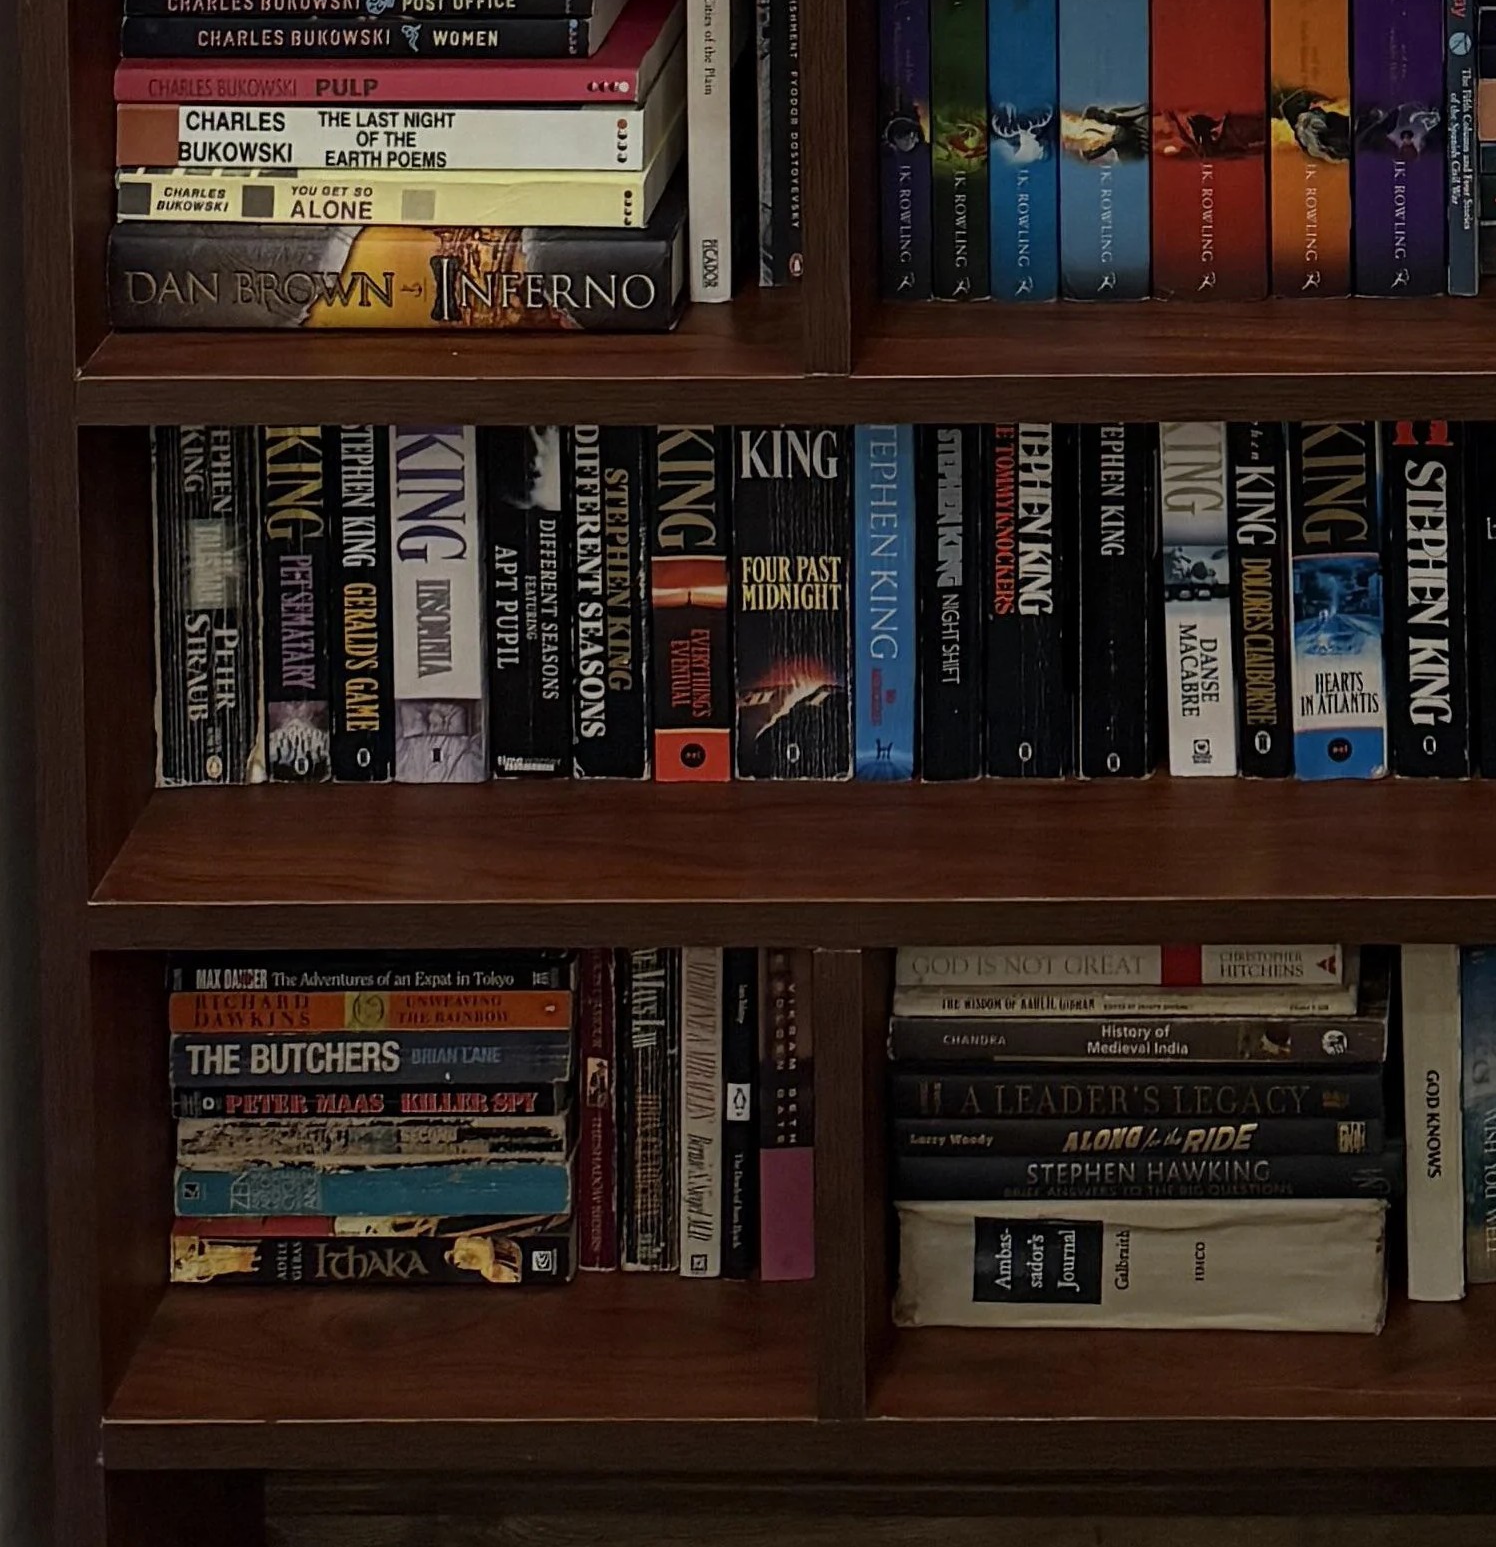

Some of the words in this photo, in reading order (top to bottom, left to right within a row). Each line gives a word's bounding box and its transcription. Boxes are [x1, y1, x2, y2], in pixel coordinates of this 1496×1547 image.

[185, 110, 285, 133] CHARLES
[318, 112, 351, 128] THE
[356, 112, 398, 128] LAST
[404, 112, 455, 128] NIGHT
[356, 131, 378, 147] OF
[382, 131, 416, 147] THE
[178, 141, 292, 162] BUKOWSKI
[325, 150, 382, 167] EARTH
[387, 150, 447, 167] POEMS
[125, 273, 218, 304] DAN
[234, 273, 395, 308] BROWN
[438, 257, 655, 320] INFERNO
[740, 430, 838, 479] KING
[741, 557, 791, 582] FOUR
[797, 557, 840, 582] PAST
[741, 584, 840, 611] MIDNIGHT
[1316, 673, 1363, 694] HEARTS
[1318, 695, 1380, 714] ATLANTIS
[272, 974, 297, 988] The
[301, 973, 373, 988] Adventures
[377, 973, 391, 987] of
[414, 972, 454, 988] Expat
[458, 973, 470, 986] in
[474, 972, 515, 988] Tokyo
[1101, 1025, 1152, 1041] History
[1154, 1025, 1170, 1038] of
[186, 1045, 239, 1076] THE
[250, 1042, 400, 1074] BUTCHERS
[1088, 1041, 1150, 1056] Medieval
[1153, 1041, 1188, 1055] India
[1027, 1162, 1134, 1184] STEPHEN
[1148, 1161, 1270, 1184] HAWKING
